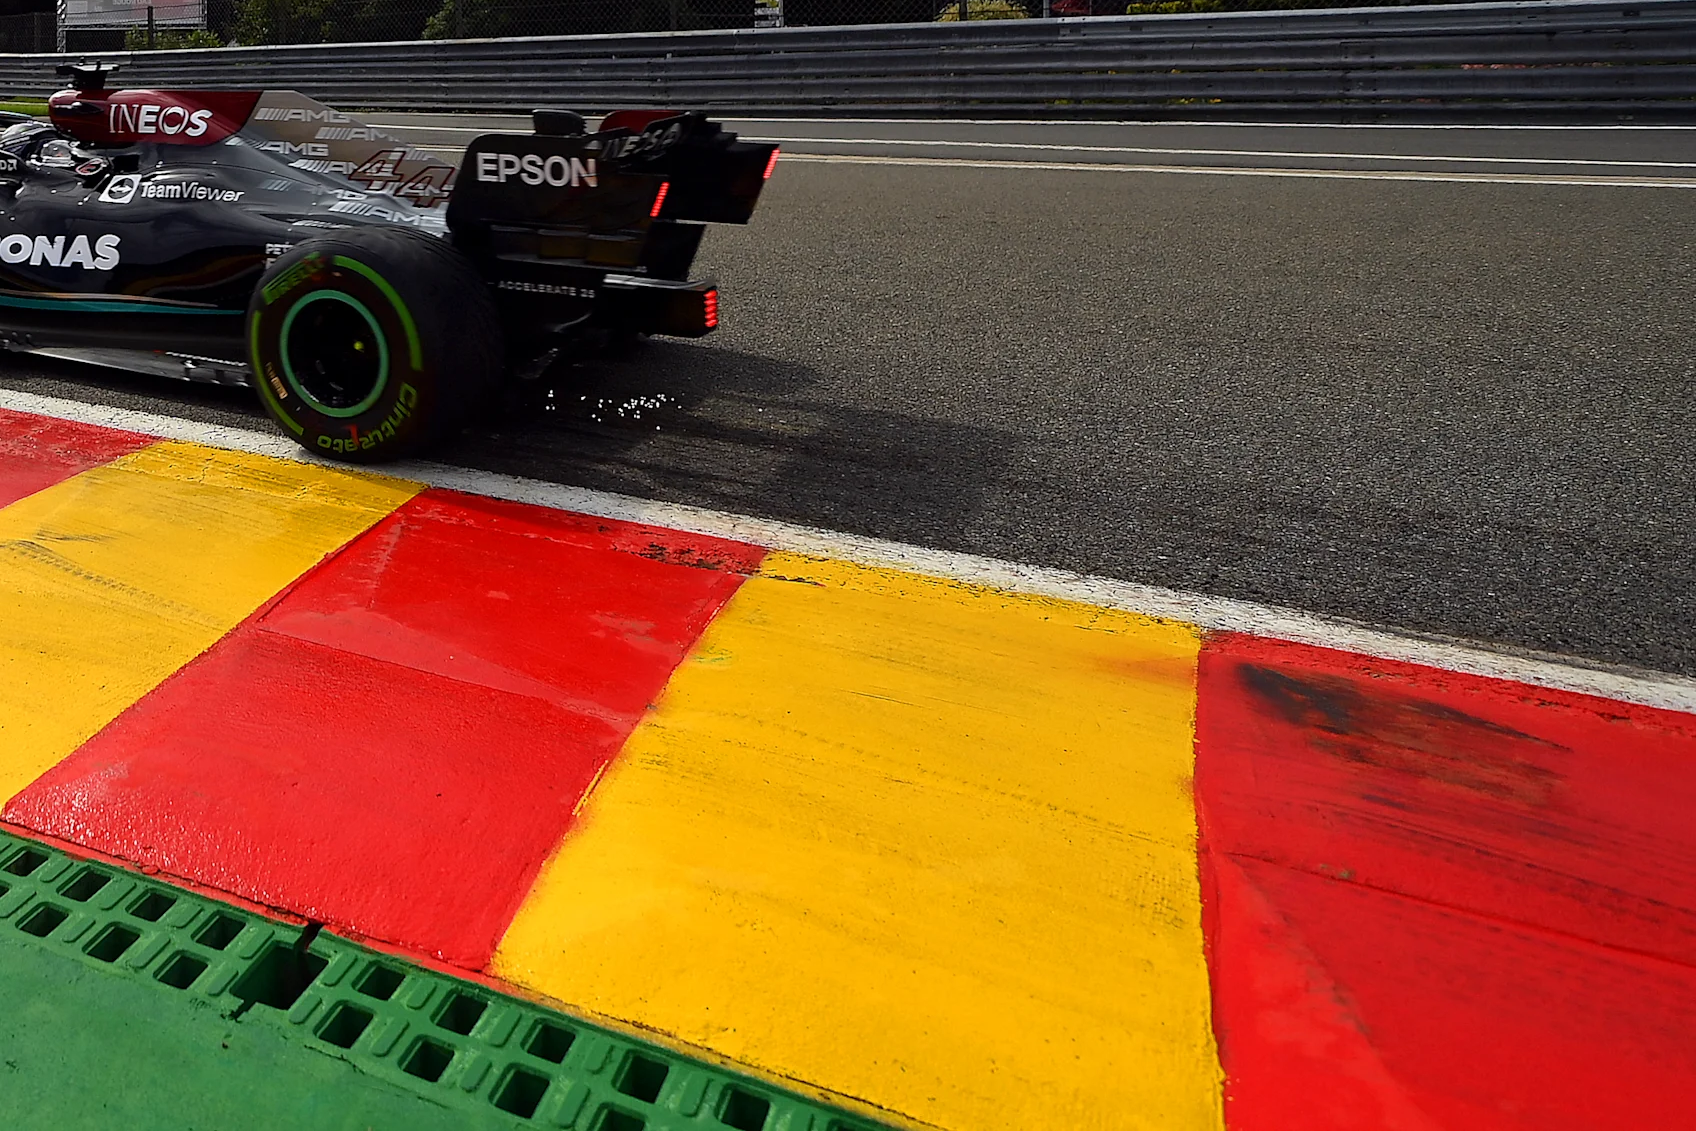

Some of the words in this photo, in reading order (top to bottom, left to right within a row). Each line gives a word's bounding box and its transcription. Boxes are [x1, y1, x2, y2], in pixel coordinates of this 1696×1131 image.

[109, 103, 213, 136] INEOS
[260, 141, 329, 156] AMG
[348, 150, 456, 208] 44
[476, 152, 598, 187] EPSON
[140, 181, 245, 202] TeamViewer
[497, 280, 577, 296] ACCELERATE
